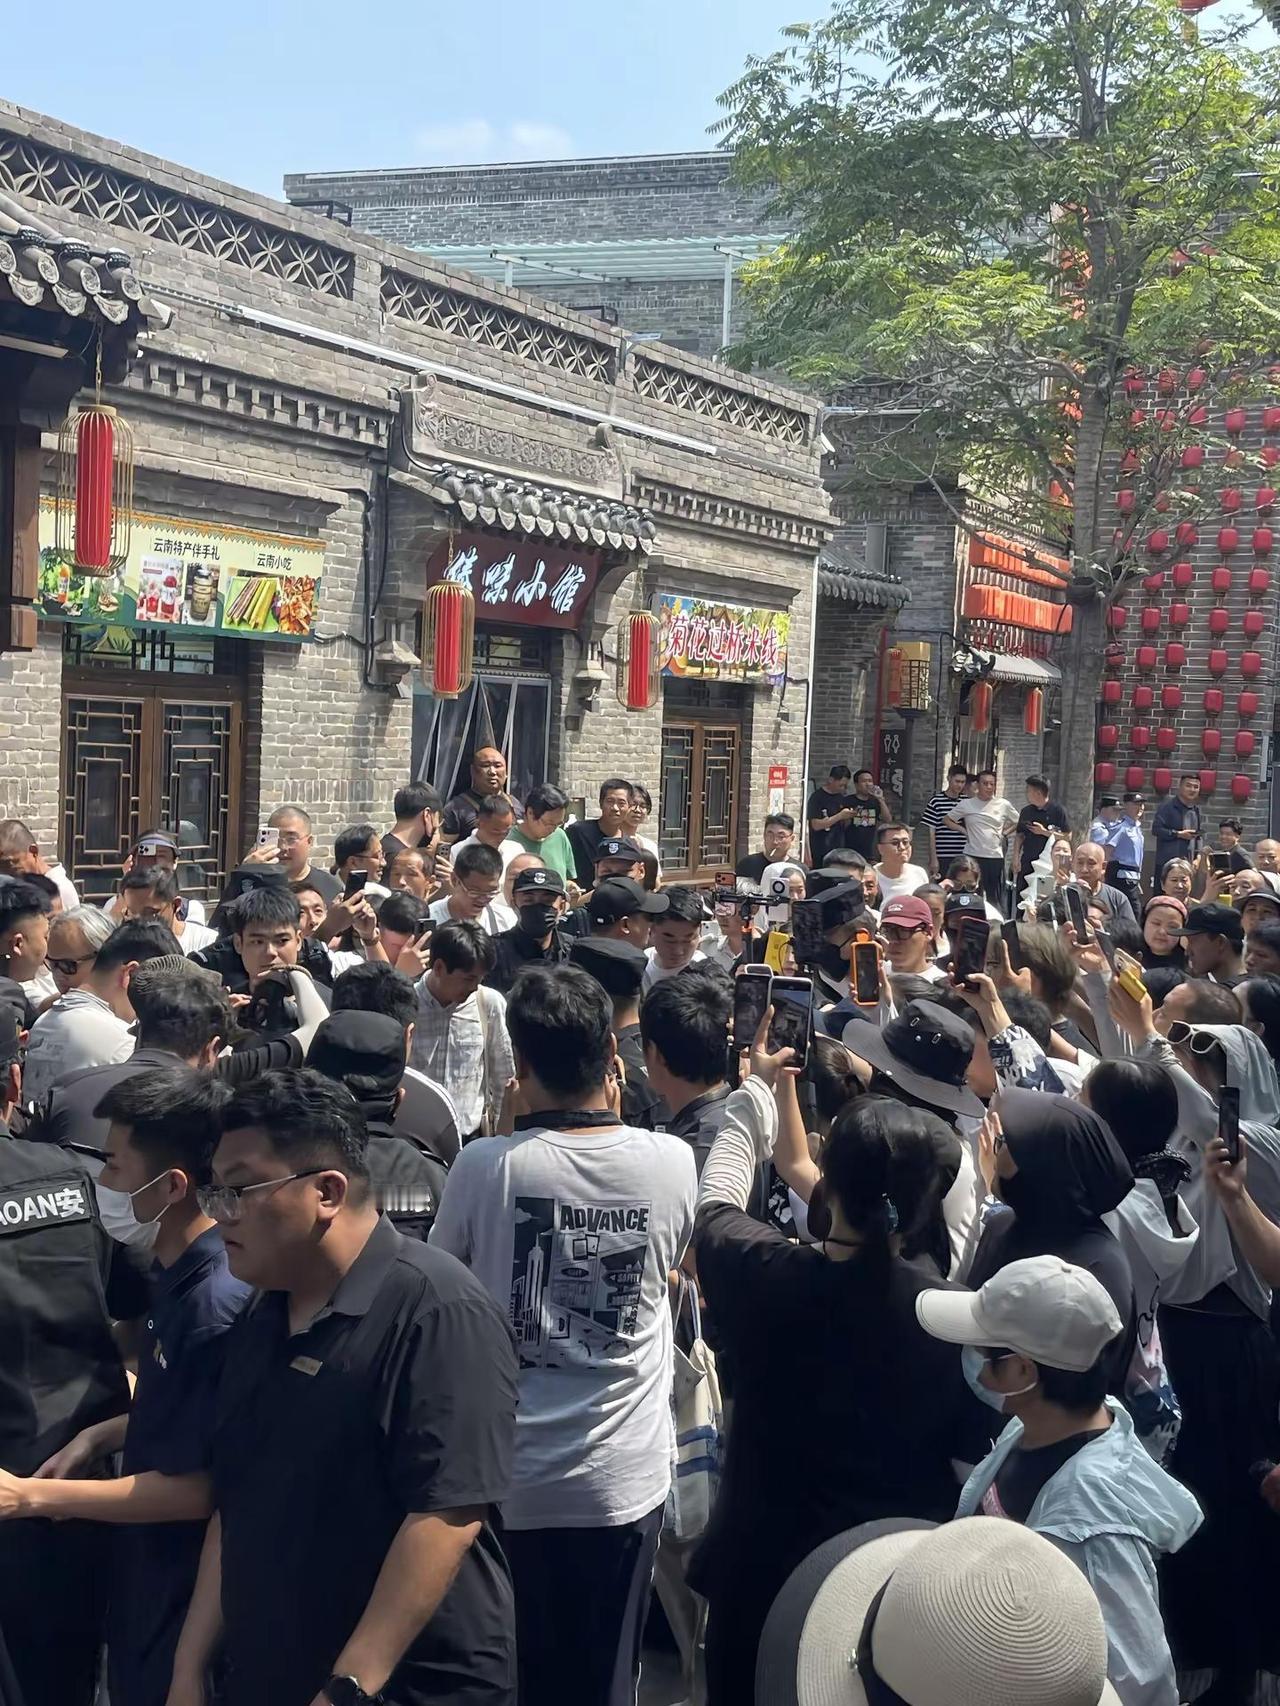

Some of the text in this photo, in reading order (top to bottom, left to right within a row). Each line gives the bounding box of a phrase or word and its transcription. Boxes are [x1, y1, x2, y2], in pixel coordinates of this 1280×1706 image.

[153, 538, 220, 560] 云南特产伴手礼
[257, 553, 292, 570] 云南小吃
[666, 614, 779, 667] 菊花过桥米线
[0, 1188, 84, 1226] OAN安
[561, 1205, 649, 1233] ADVANCE
